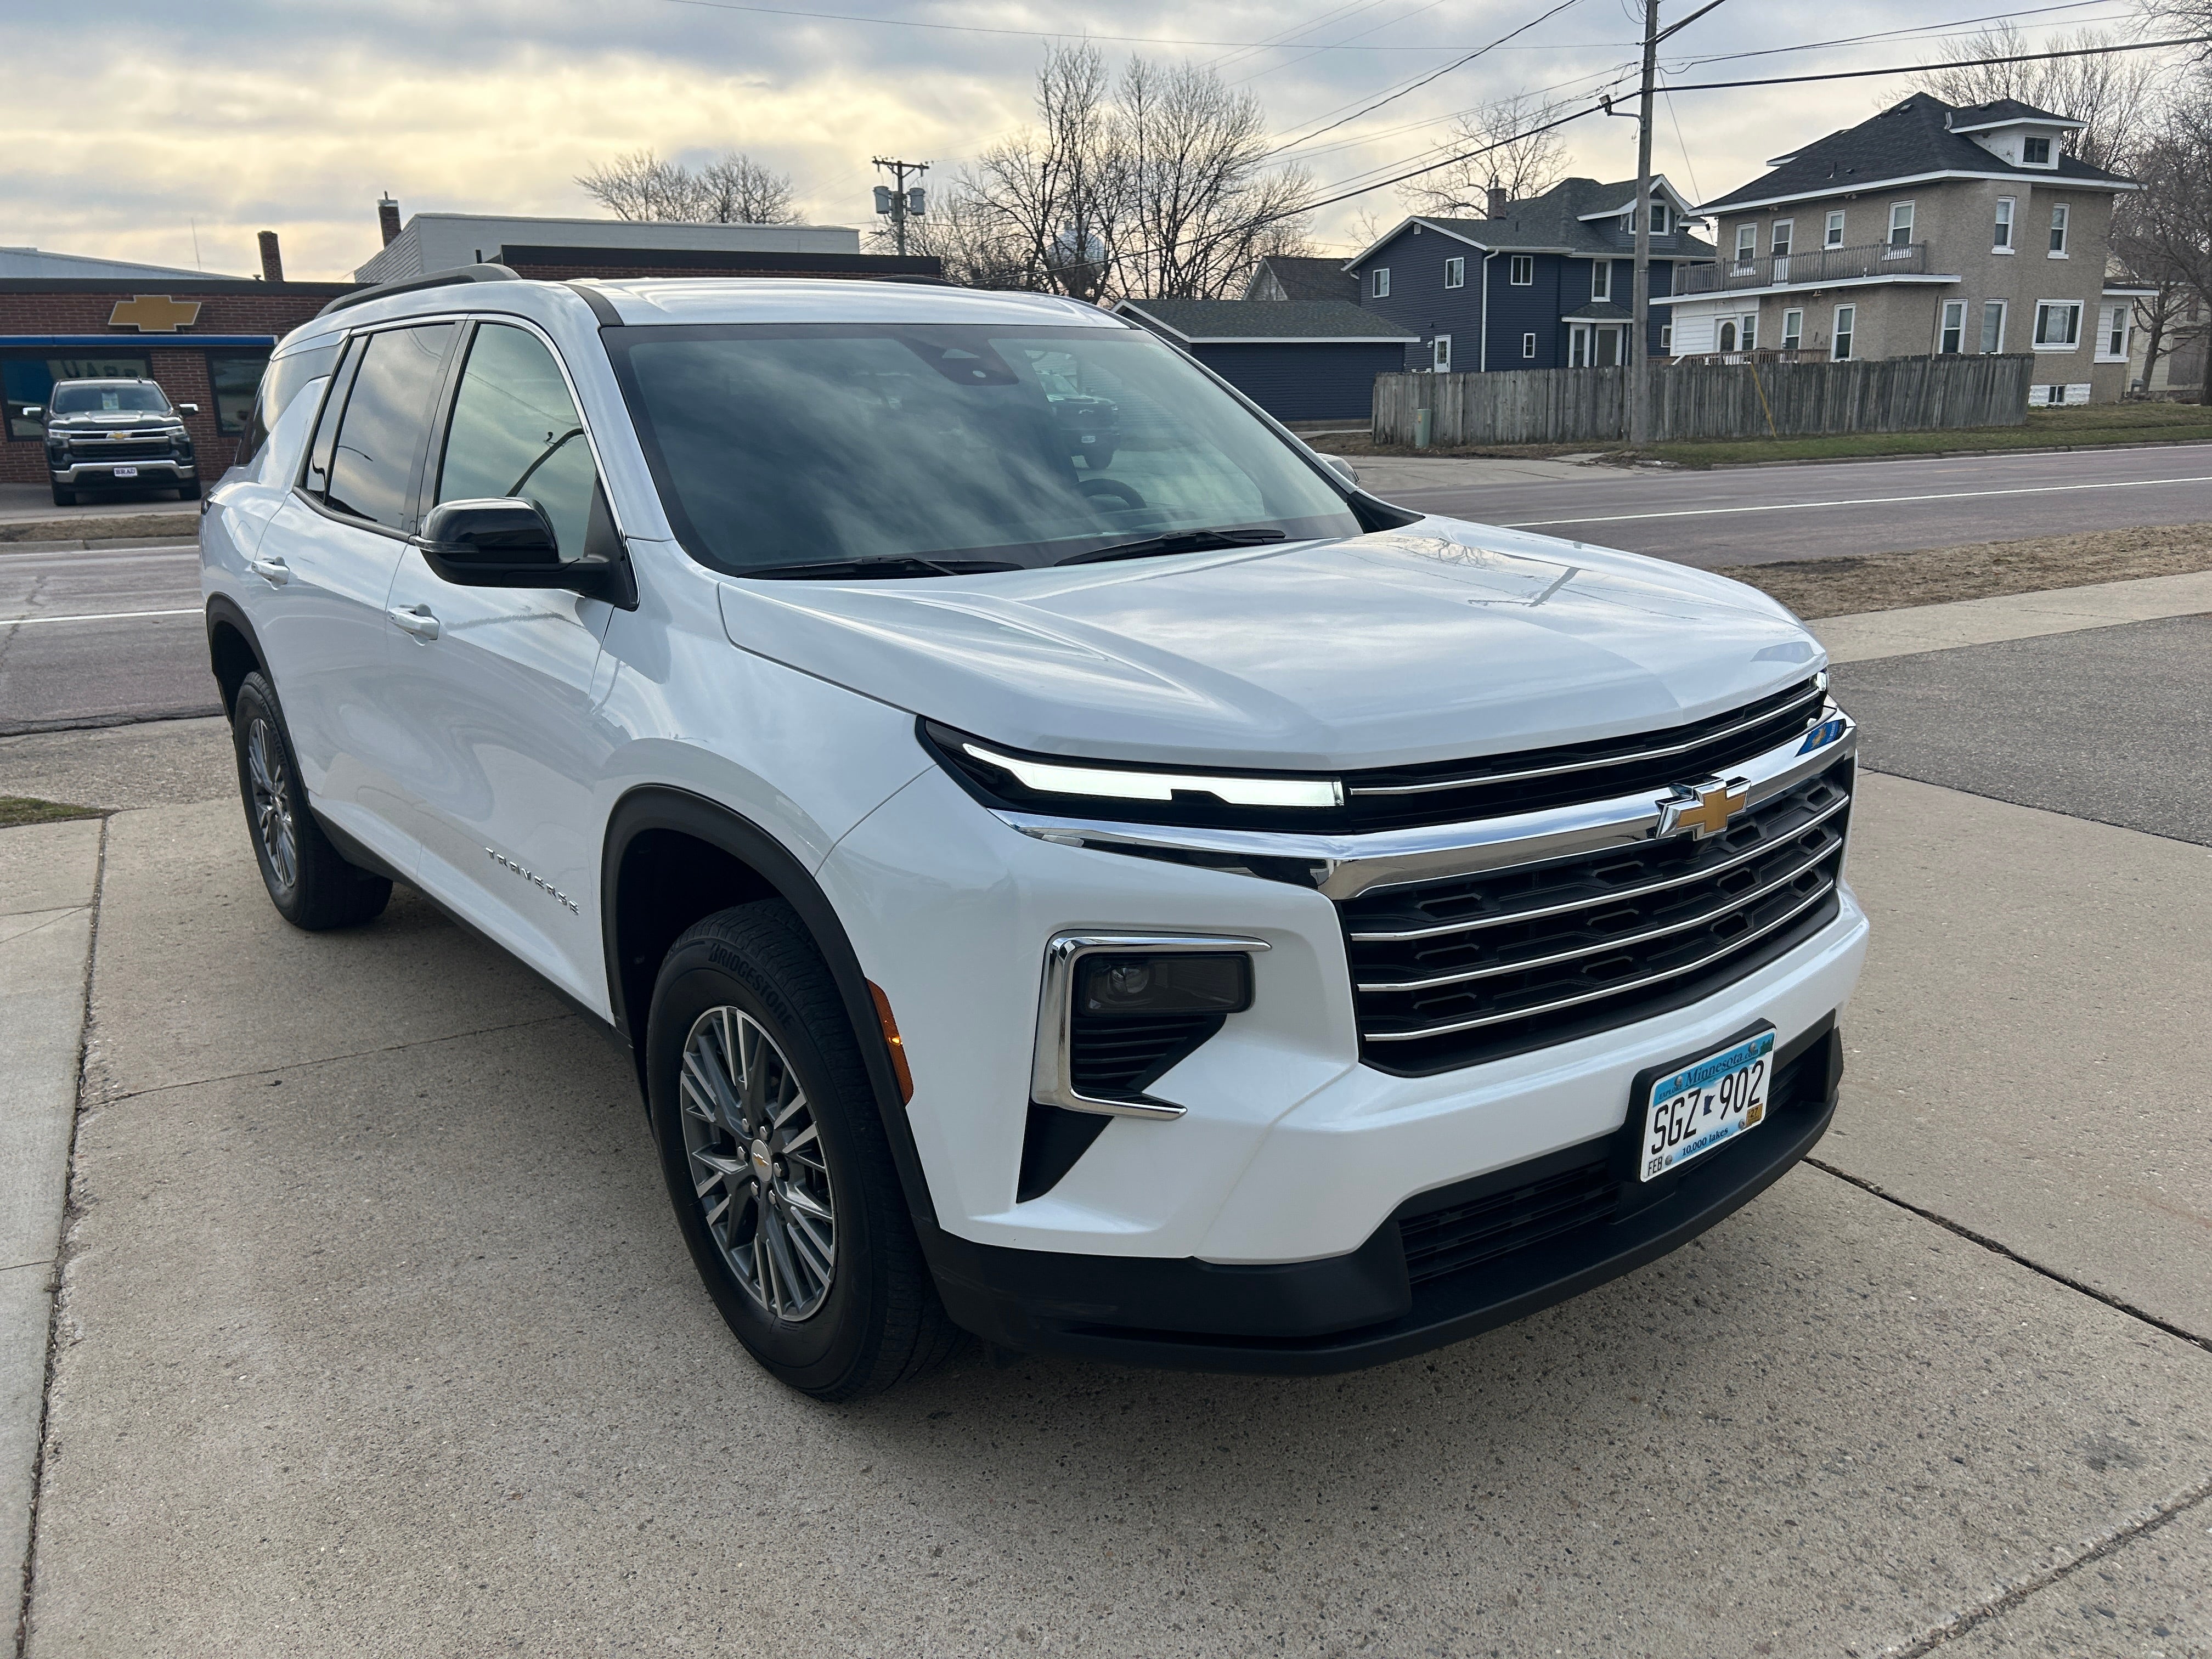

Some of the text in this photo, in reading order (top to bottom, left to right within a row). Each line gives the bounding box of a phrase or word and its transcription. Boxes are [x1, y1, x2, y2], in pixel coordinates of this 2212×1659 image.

[485, 847, 580, 916] TRAVERSE
[708, 943, 795, 1030] BRIDGESTONE
[1651, 1060, 1764, 1155] SGZ 902
[1709, 1127, 1728, 1141] lakes
[1648, 1156, 1663, 1176] FEB
